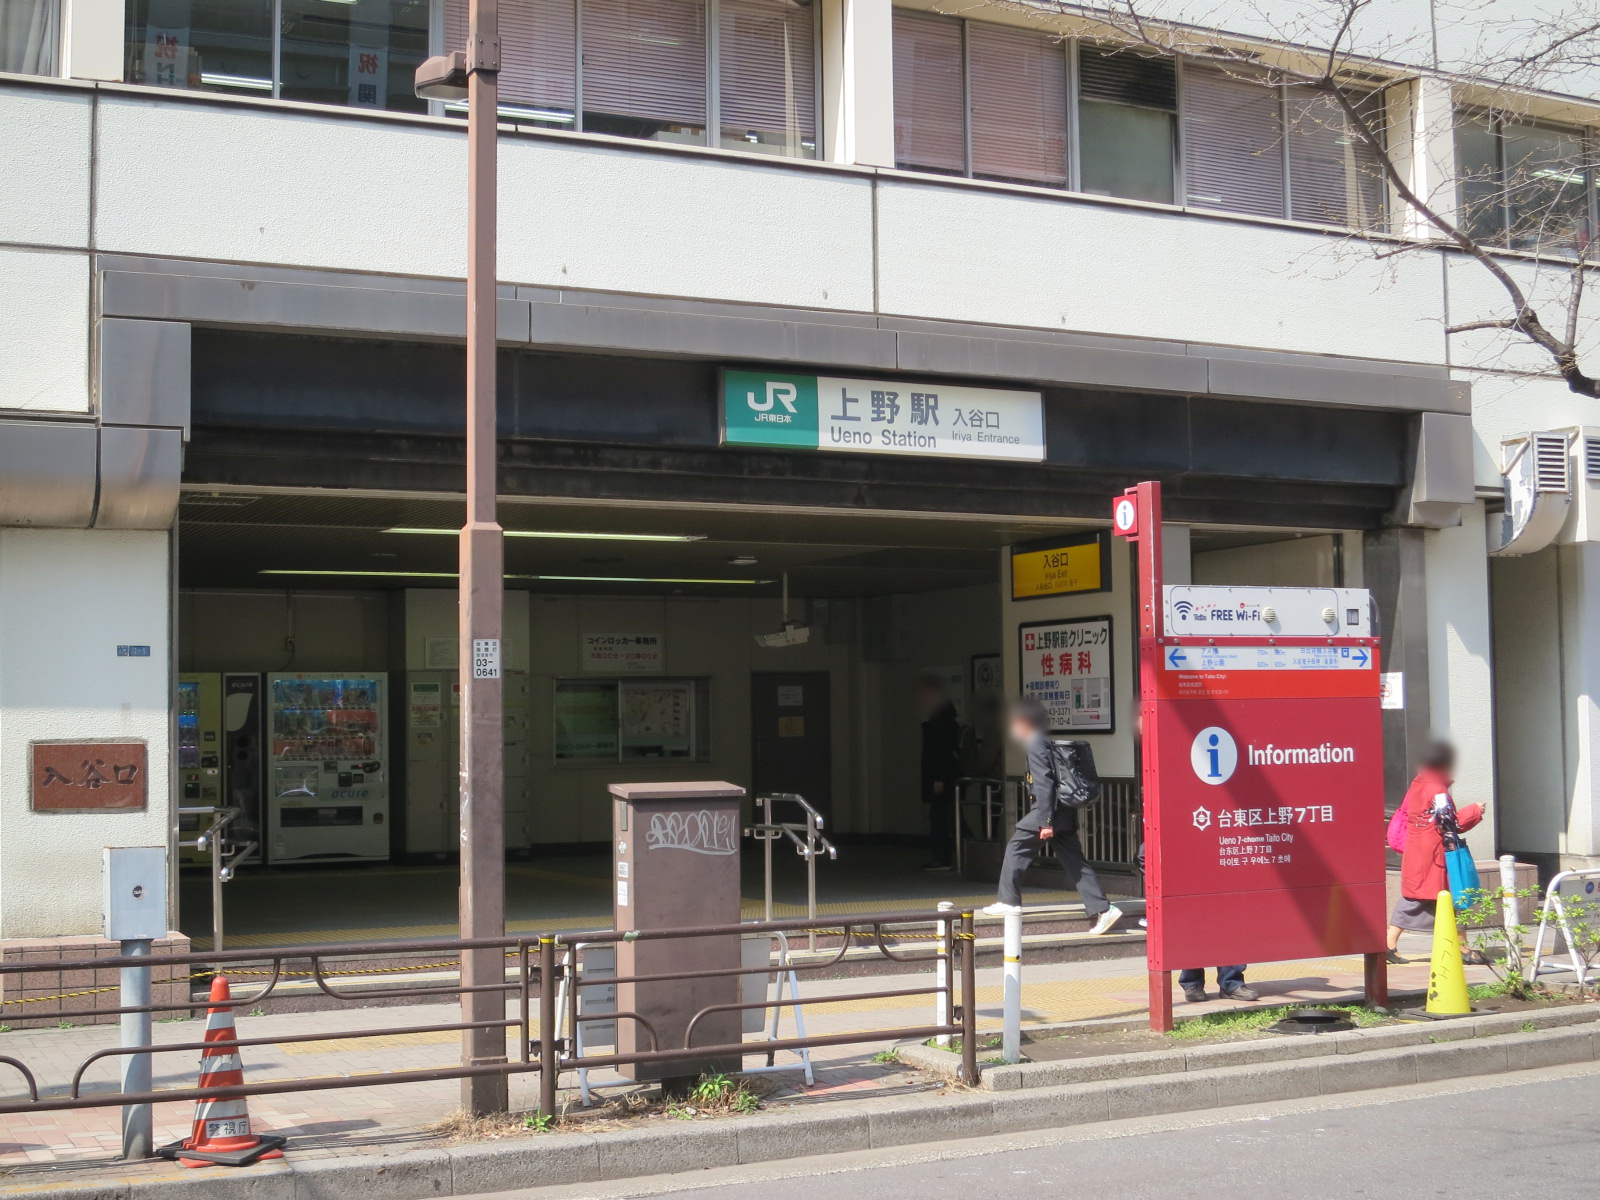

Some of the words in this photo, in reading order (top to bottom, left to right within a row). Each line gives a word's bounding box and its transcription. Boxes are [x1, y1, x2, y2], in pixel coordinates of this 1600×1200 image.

[747, 381, 798, 413] JR
[830, 387, 940, 426] 上野駅
[754, 412, 792, 423] JR東日本
[952, 408, 1001, 430] 入谷口
[830, 425, 873, 444] Ueno
[881, 429, 938, 449] Station
[951, 430, 973, 442] Iriya
[976, 432, 1021, 445] Entrance
[1043, 552, 1069, 569] 入谷口
[1210, 609, 1233, 621] FREE
[1236, 609, 1261, 621] Wi-Fi
[587, 637, 657, 645] コインロッカー事務所
[1036, 627, 1108, 650] 上野駅前クリニック
[476, 658, 494, 667] 03-
[1041, 650, 1092, 677] 性病科
[476, 668, 498, 677] 0641
[1248, 742, 1354, 766] Information
[42, 758, 139, 790] 入谷口
[331, 790, 369, 799] acure
[1217, 805, 1333, 828] 台東区上野7丁目
[1219, 836, 1236, 845] Ueno
[1237, 835, 1265, 845] 7-chome
[1265, 833, 1280, 843] Taito
[1281, 832, 1294, 843] City
[208, 1120, 248, 1136] 警視庁
